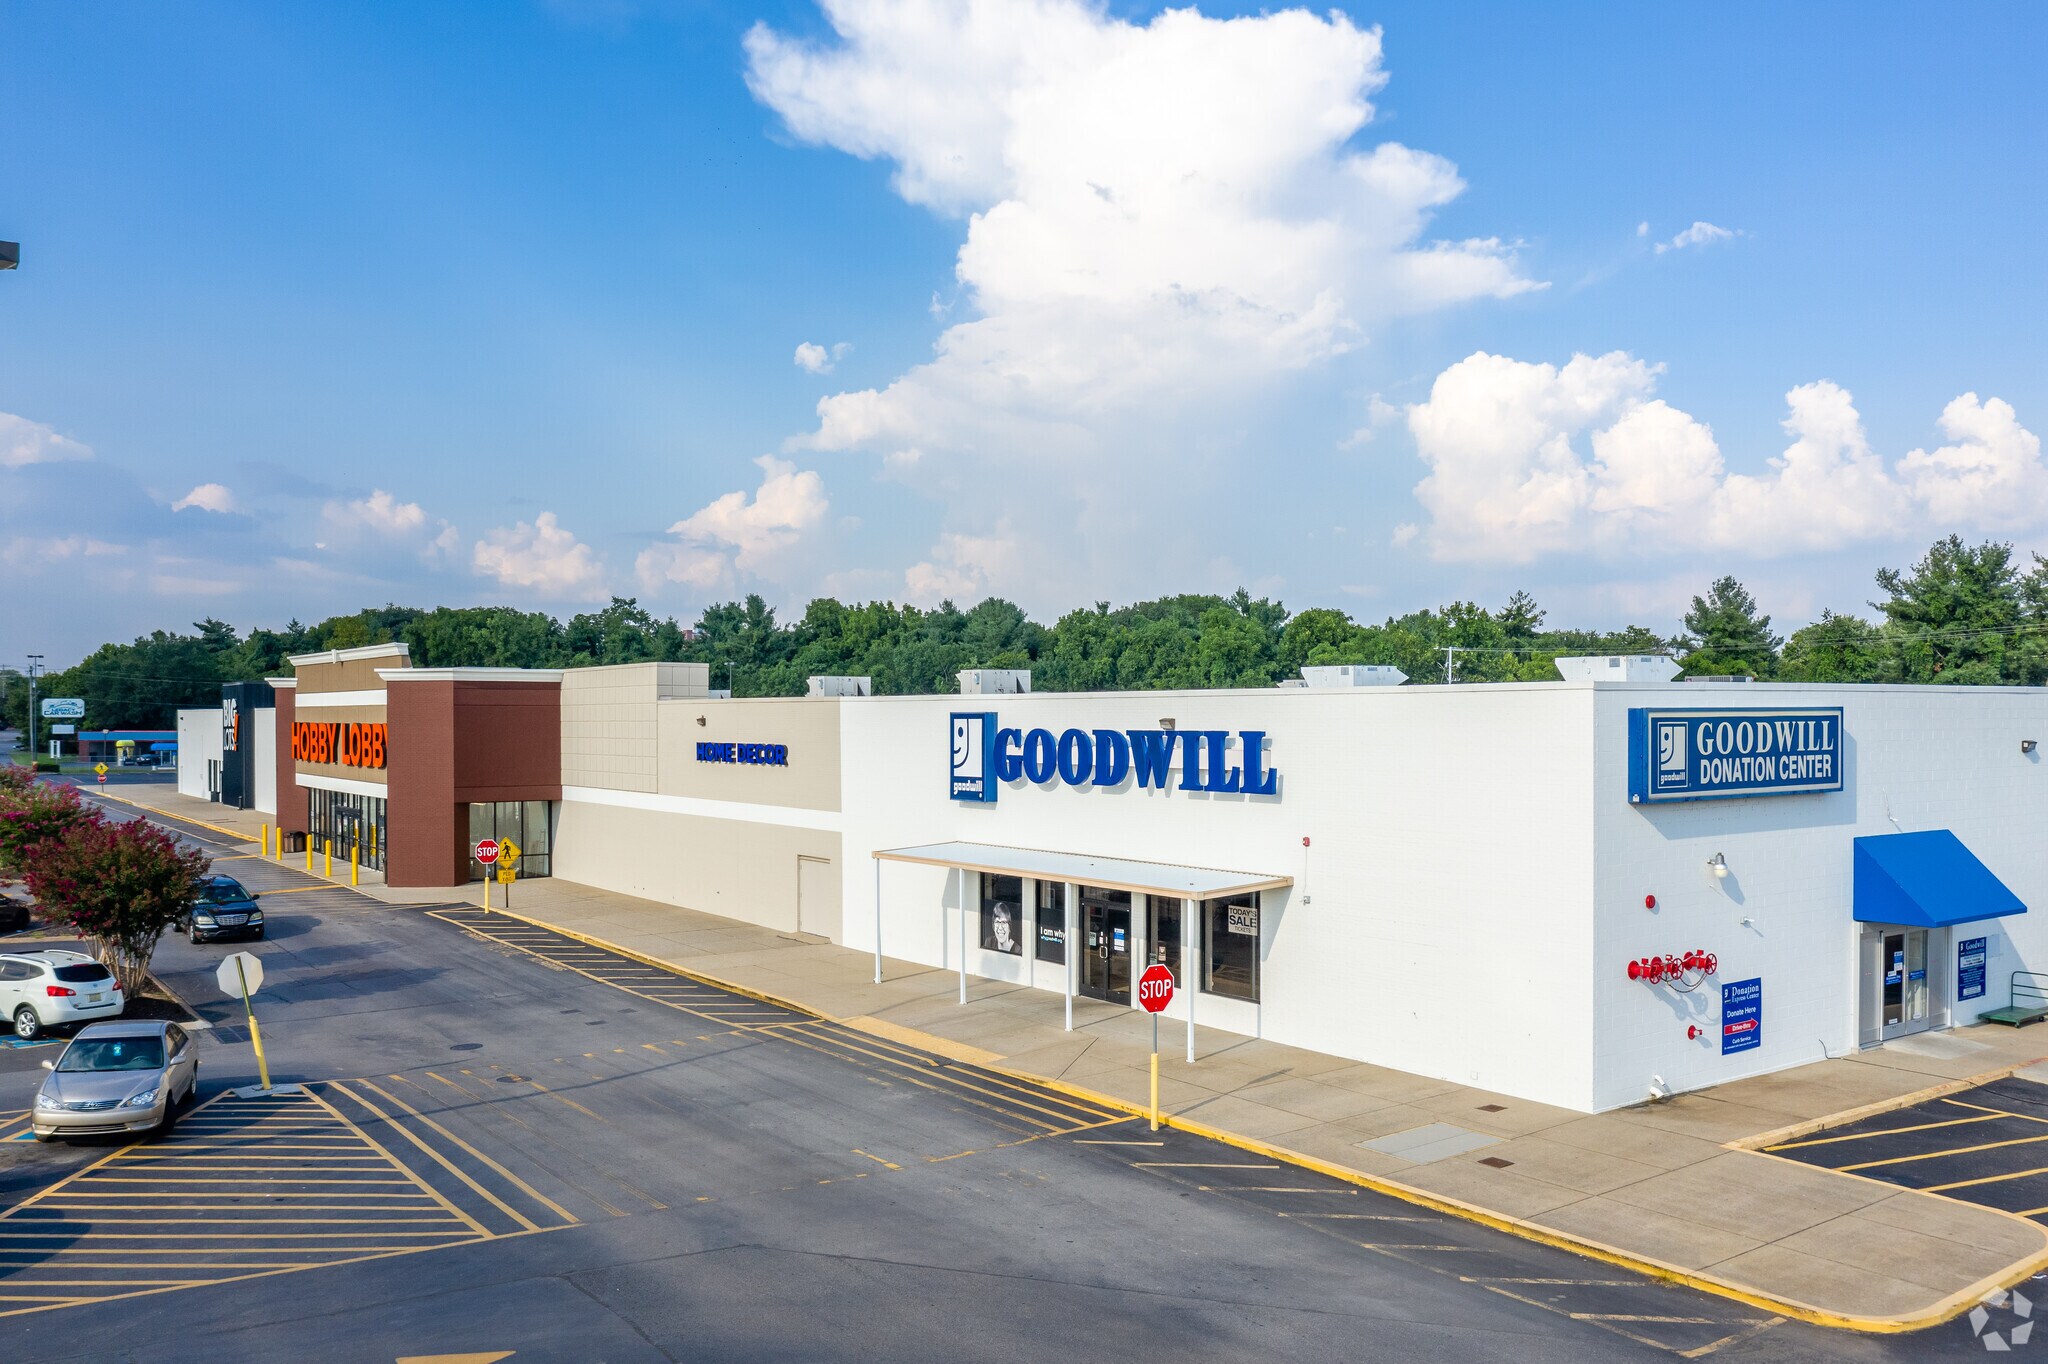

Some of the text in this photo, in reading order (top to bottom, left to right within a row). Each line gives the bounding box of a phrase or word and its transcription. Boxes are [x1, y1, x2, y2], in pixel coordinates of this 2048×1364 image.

[224, 698, 237, 727] BIG
[291, 722, 338, 764] HOBBY
[1696, 720, 1834, 756] GOODWILL
[696, 742, 786, 766] HOME DECOR
[993, 727, 1278, 795] GOODWILL
[1700, 754, 1832, 785] DONATION CENTER
[1660, 771, 1686, 785] goodwill
[953, 779, 983, 795] goodwill
[477, 847, 498, 857] STOP
[1230, 908, 1256, 917] TODAY'S
[1229, 914, 1256, 928] SALE
[1043, 928, 1054, 937] am
[1141, 979, 1172, 999] STOP
[1732, 984, 1760, 997] Donation
[1726, 1006, 1757, 1018] Donate Here
